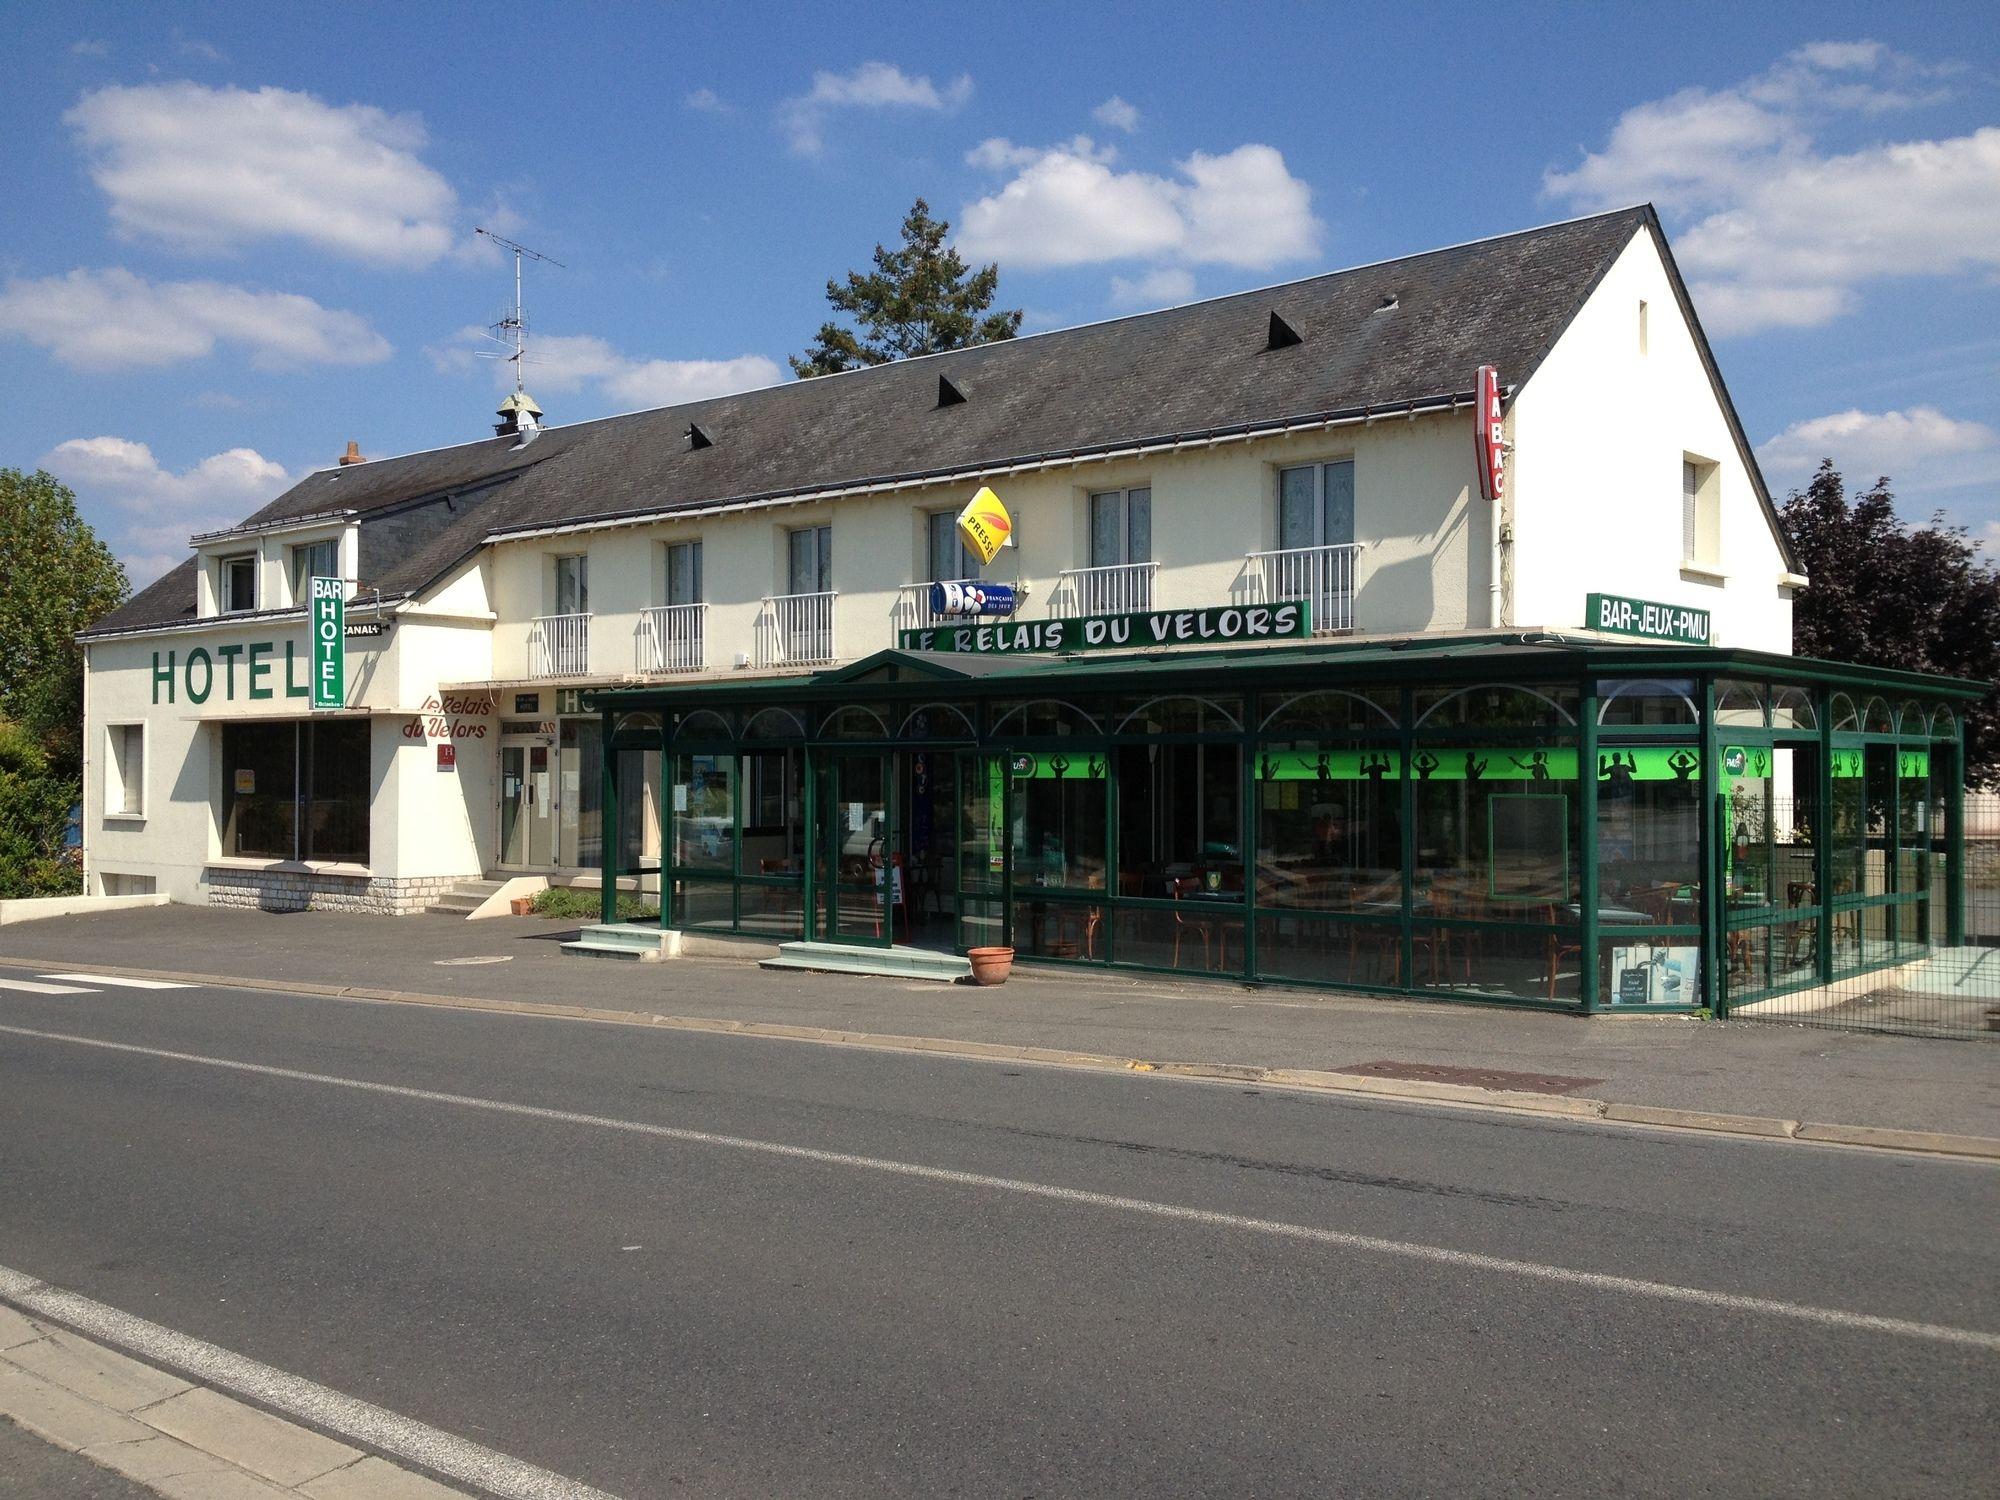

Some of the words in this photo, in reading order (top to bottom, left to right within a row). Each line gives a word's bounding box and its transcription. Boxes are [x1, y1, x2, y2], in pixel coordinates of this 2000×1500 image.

[1490, 371, 1504, 494] TABAC
[968, 516, 995, 557] PRESSE
[314, 580, 342, 599] BAR
[320, 601, 337, 699] HOTEL
[953, 622, 1064, 652] RELAIS
[1085, 617, 1130, 644] DU
[1150, 606, 1298, 641] VELORS
[152, 640, 309, 704] HOTEL
[438, 696, 492, 716] Relais
[403, 718, 425, 738] du
[427, 717, 487, 739] Velors
